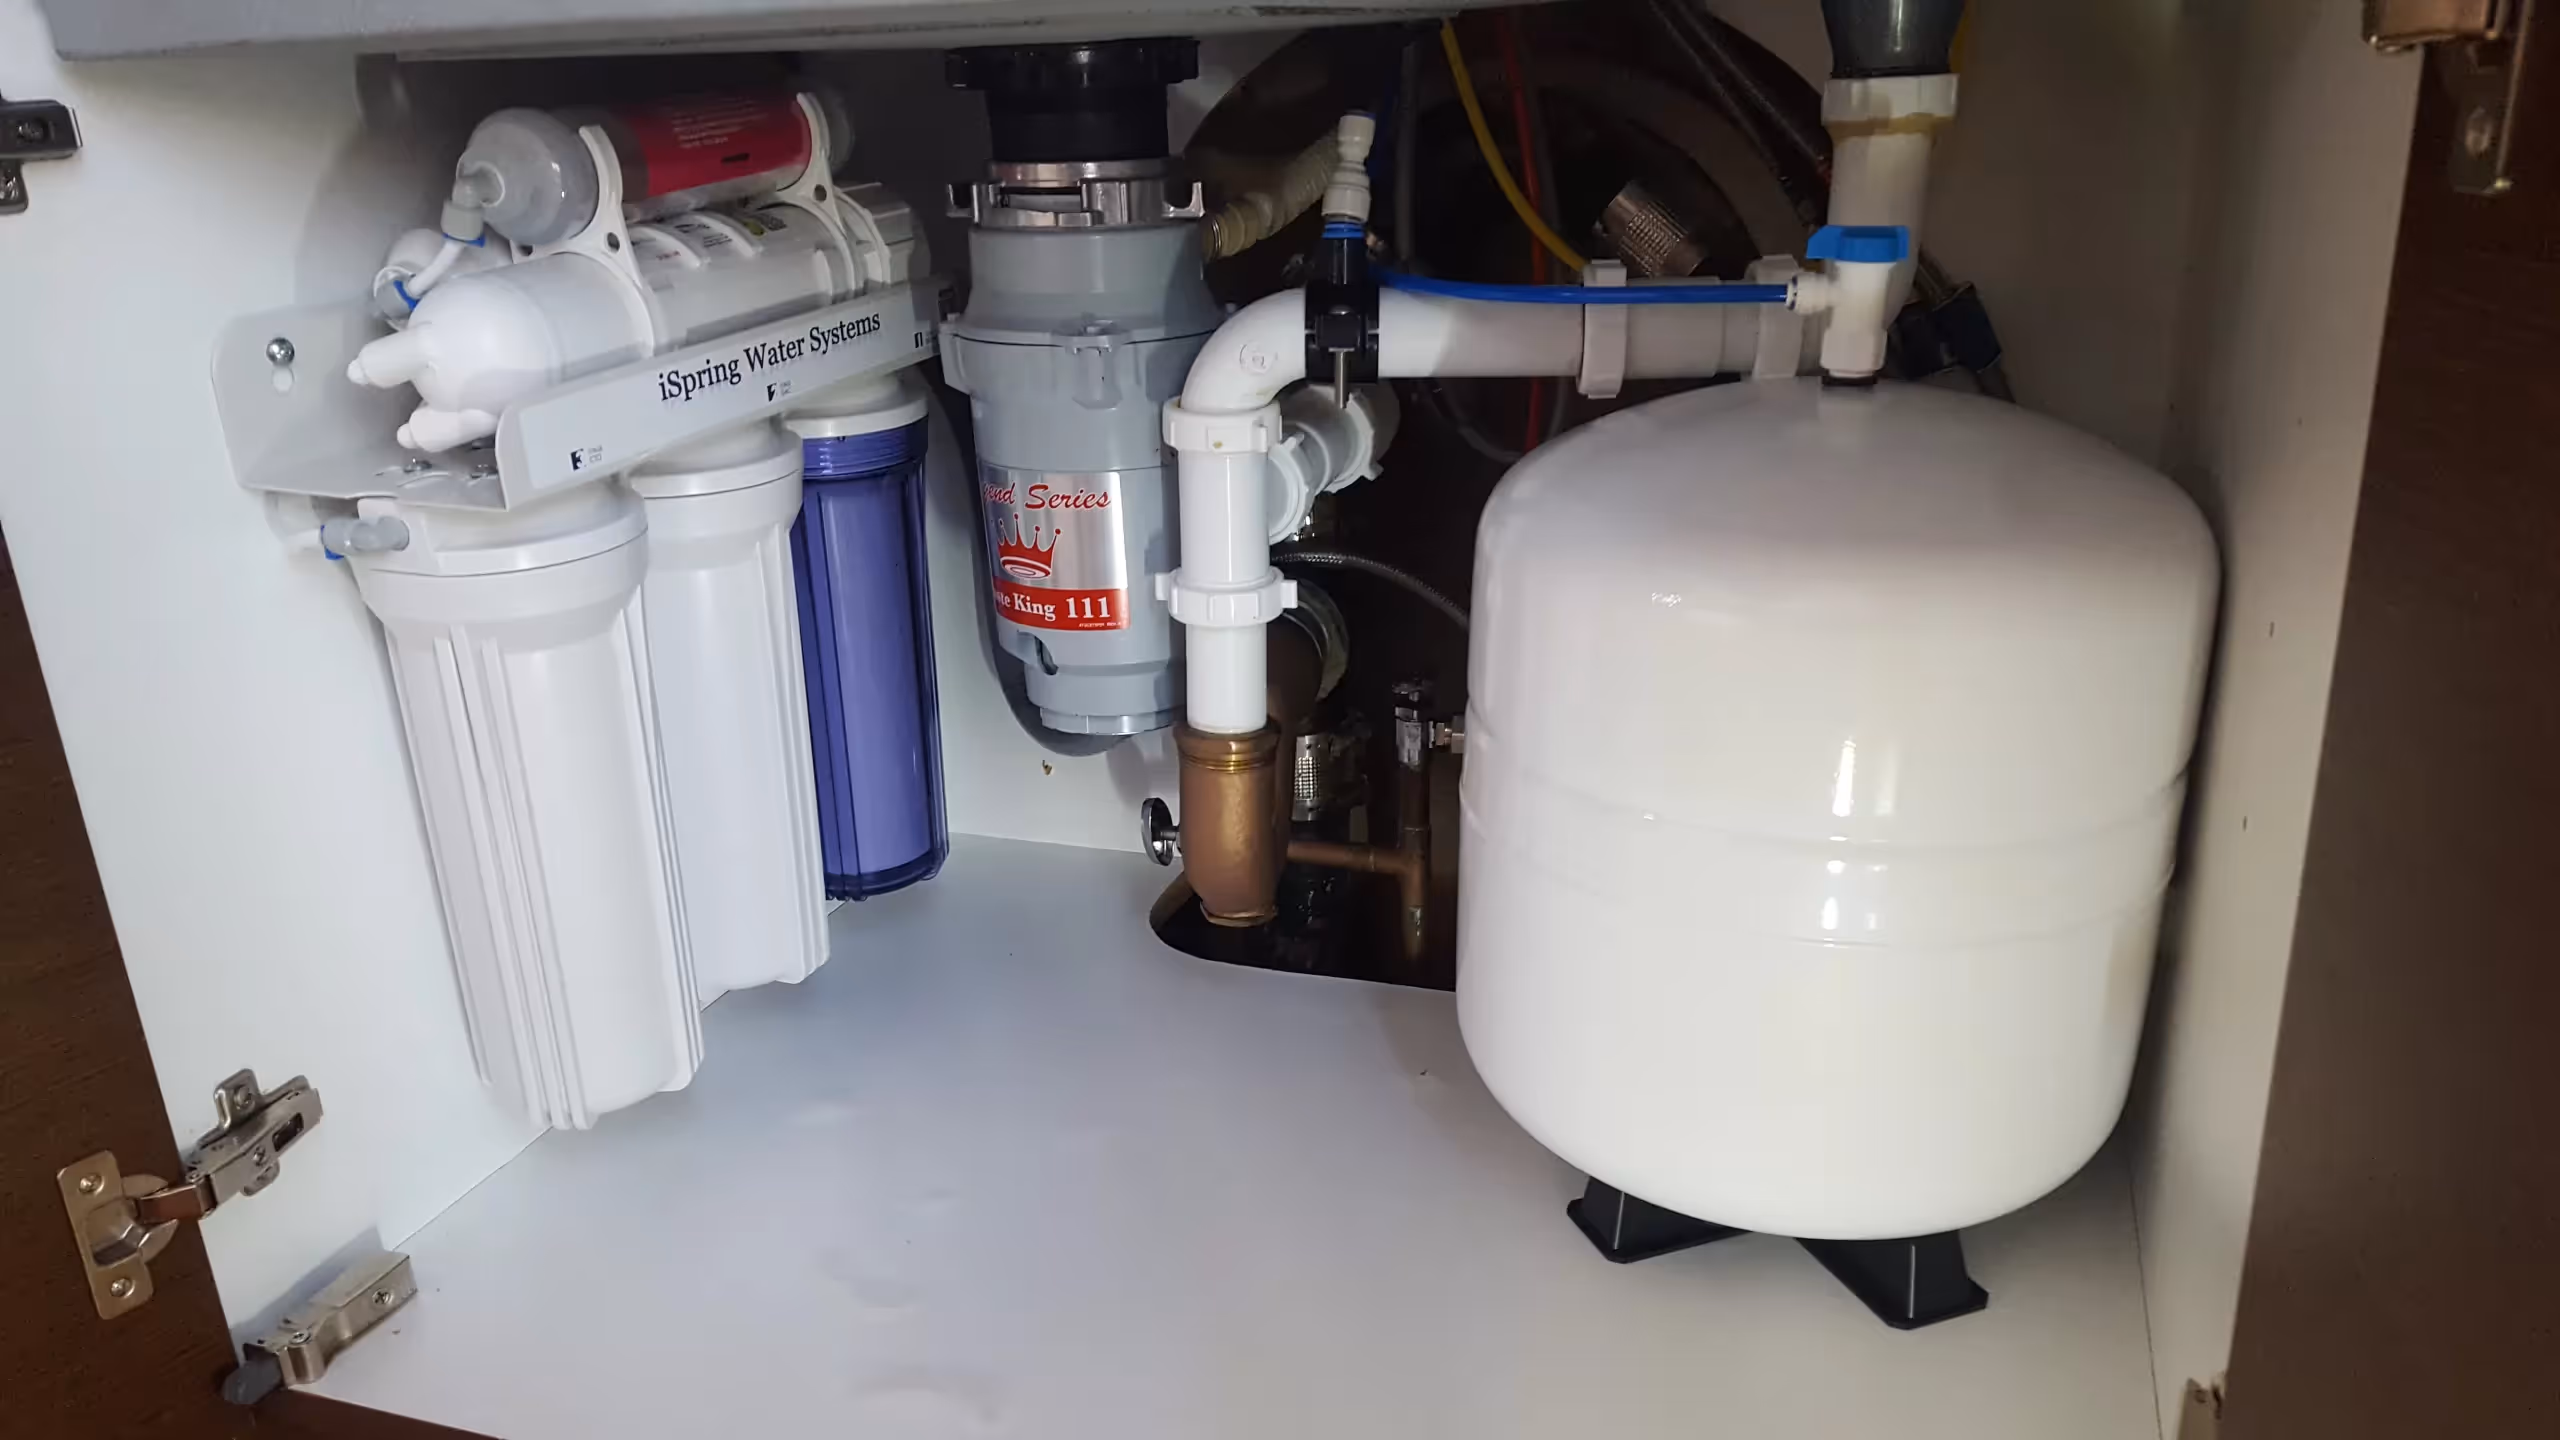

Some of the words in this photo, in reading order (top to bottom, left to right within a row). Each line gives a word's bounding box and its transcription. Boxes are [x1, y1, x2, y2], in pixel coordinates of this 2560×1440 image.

[658, 358, 742, 402] iSpring
[743, 336, 805, 373] Water
[809, 312, 881, 355] Systems
[1025, 483, 1111, 510] Series
[1013, 592, 1057, 622] King
[1066, 596, 1111, 618] 111
